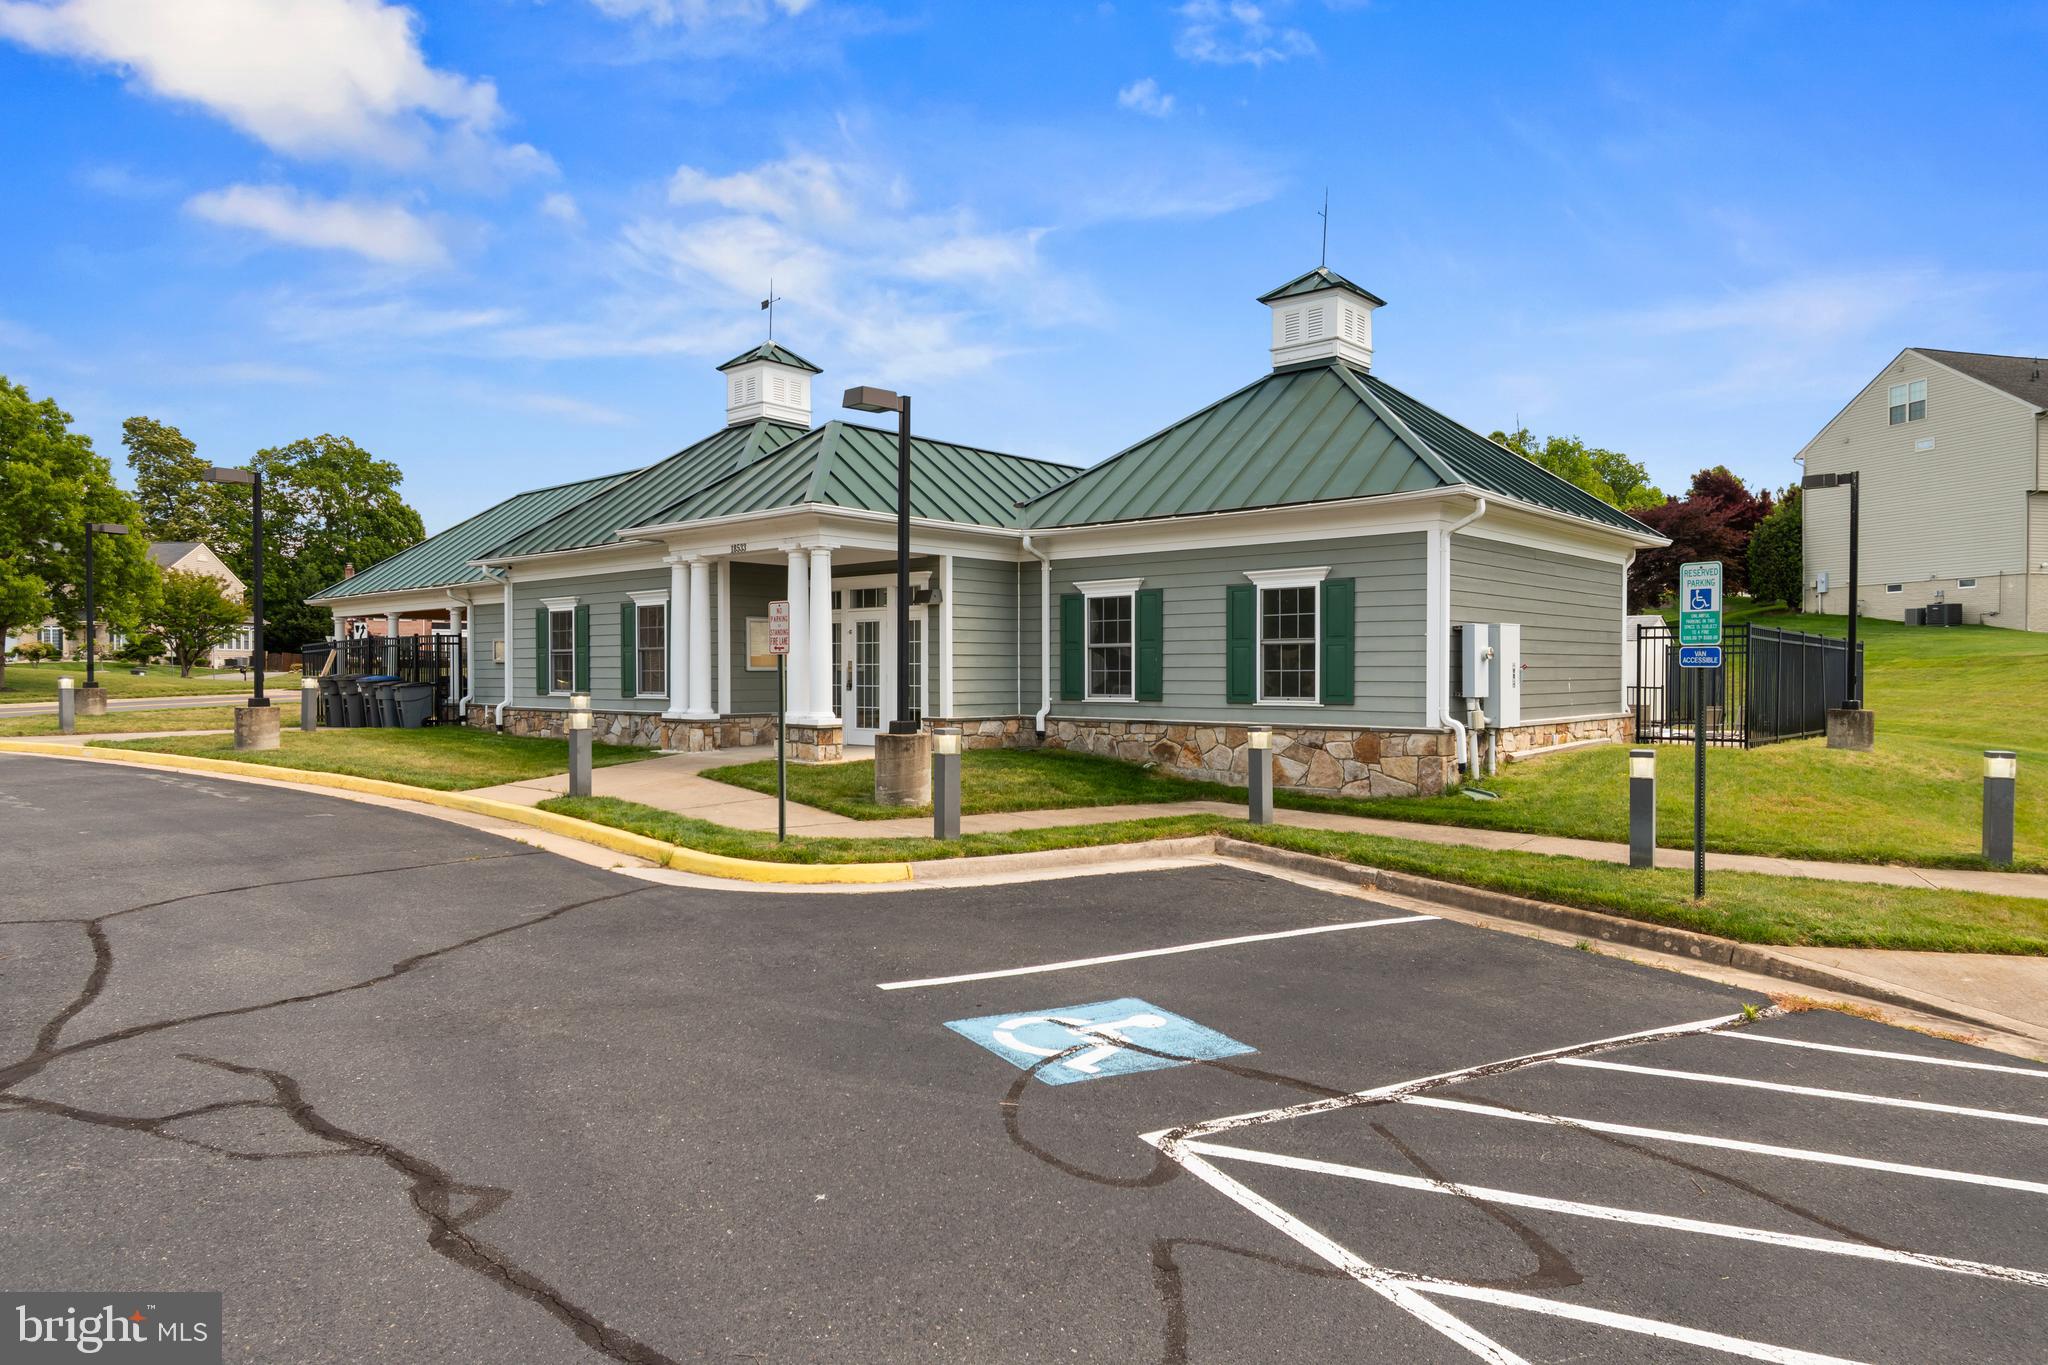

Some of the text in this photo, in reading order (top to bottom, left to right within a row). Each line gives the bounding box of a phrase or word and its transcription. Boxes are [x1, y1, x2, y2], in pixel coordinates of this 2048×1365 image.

[1683, 568, 1719, 577] RESERVED
[1687, 579, 1715, 587] PARKING
[770, 637, 788, 645] FIRE LANE
